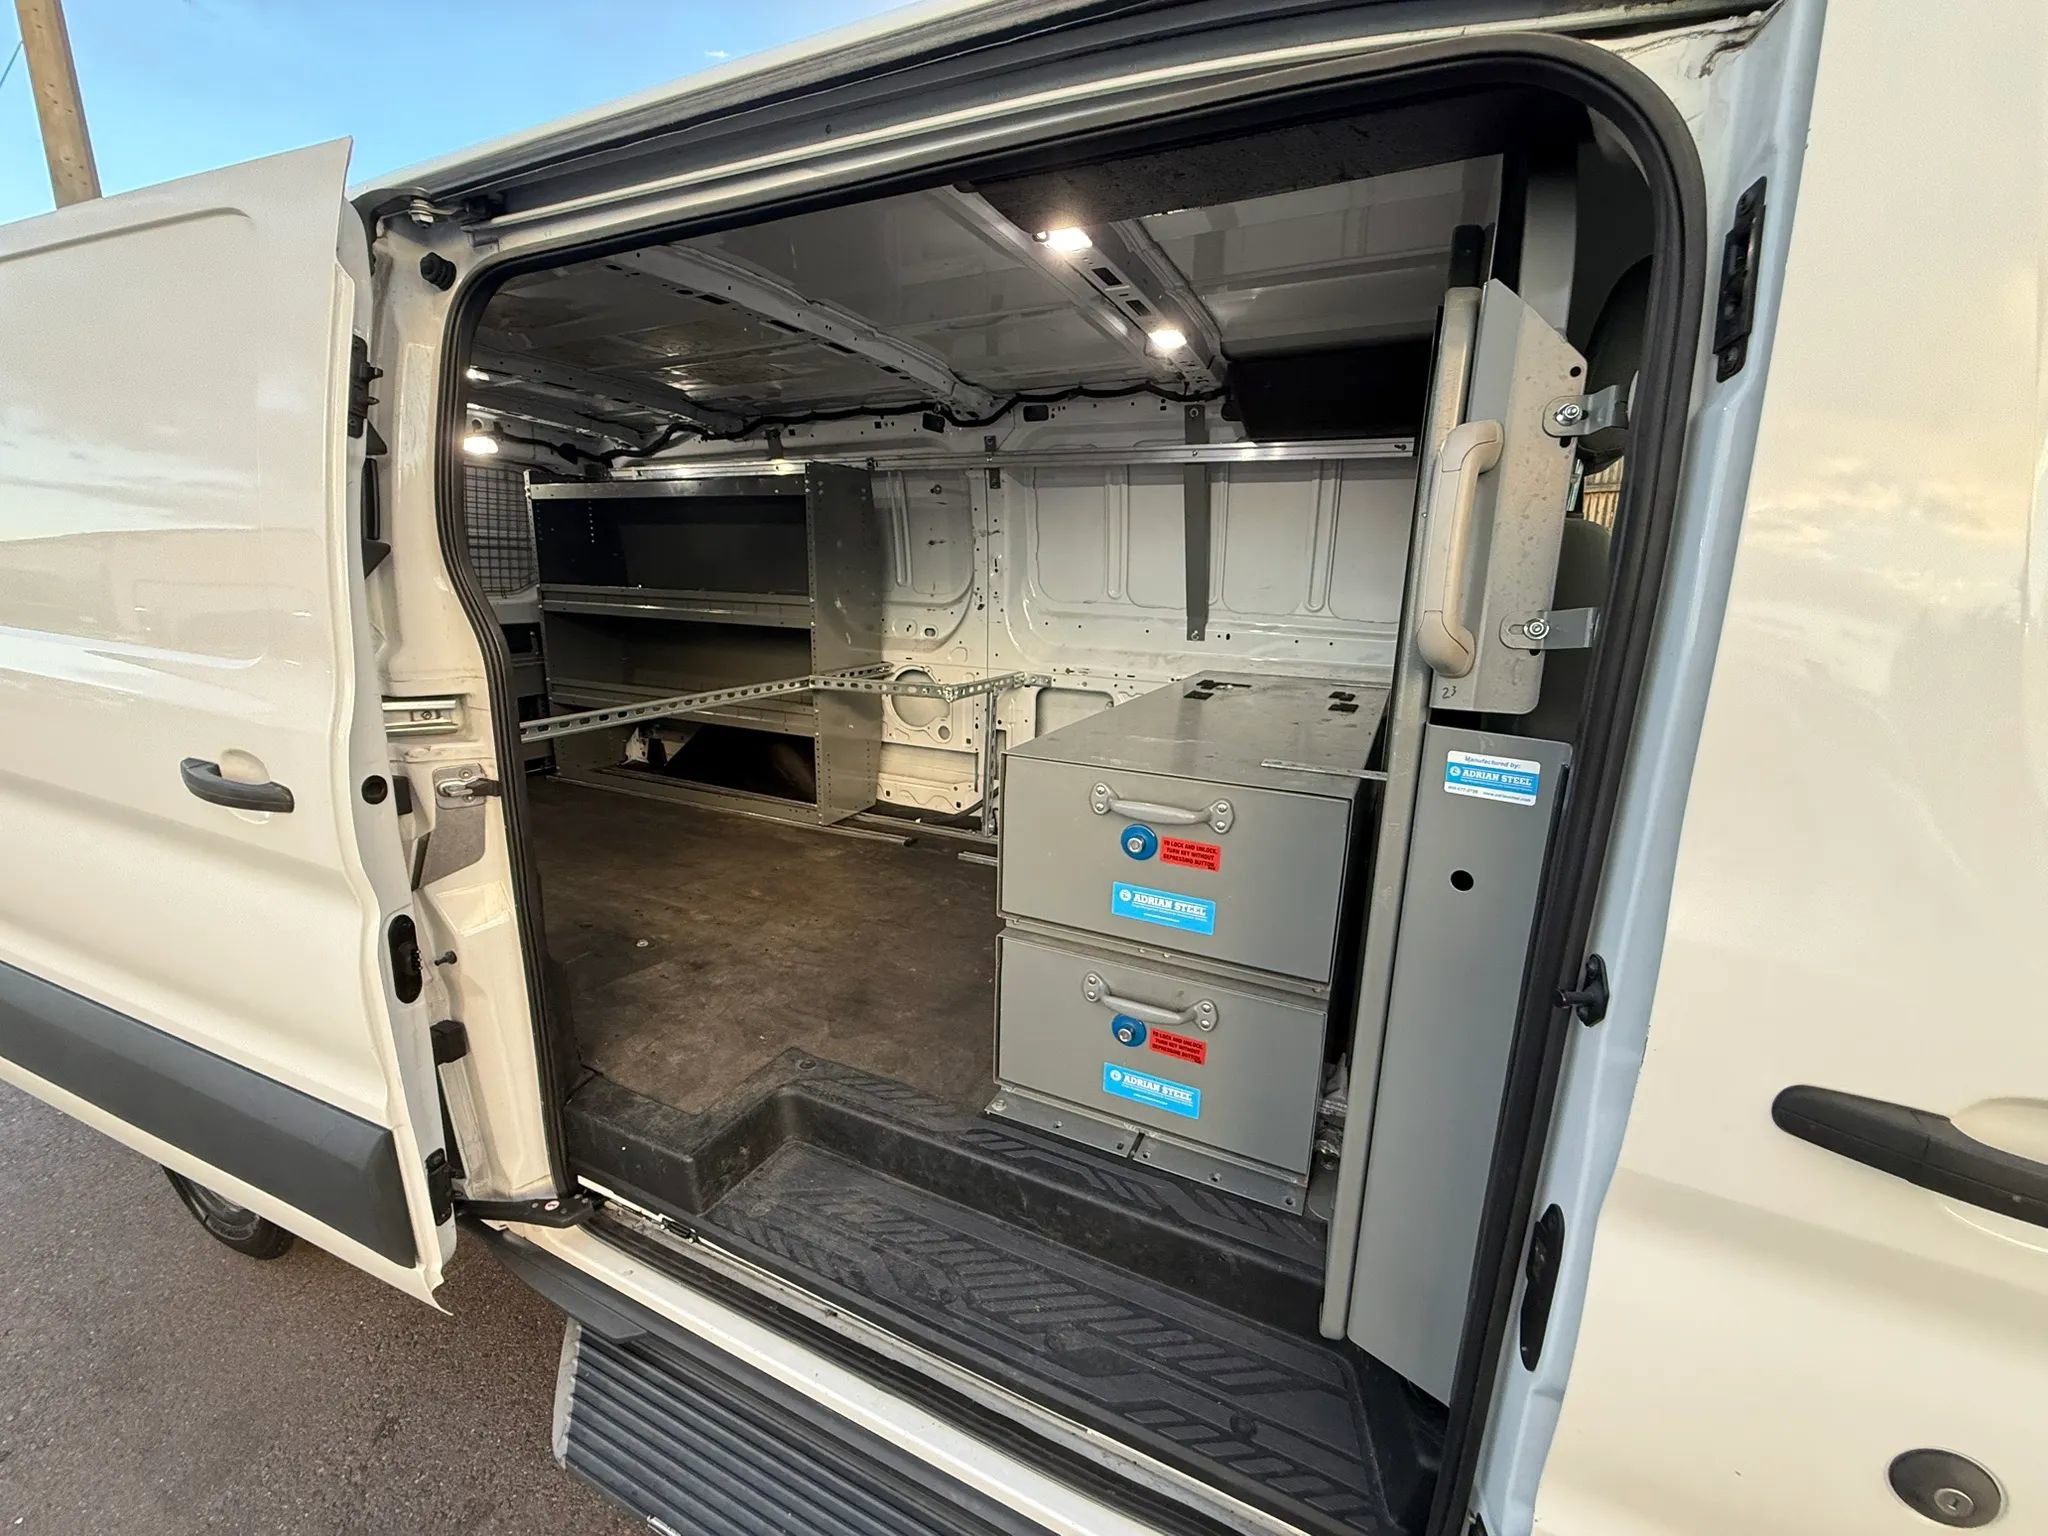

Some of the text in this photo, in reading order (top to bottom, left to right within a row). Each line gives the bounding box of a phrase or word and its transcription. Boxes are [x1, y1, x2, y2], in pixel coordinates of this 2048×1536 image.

[1442, 685, 1457, 699] 23
[1464, 755, 1509, 767] Manufactured
[1462, 769, 1499, 782] ADRIAN
[1501, 774, 1532, 786] STEEL
[1171, 841, 1184, 849] LOCK
[1167, 847, 1180, 855] TURN
[1191, 852, 1215, 861] WITHOUT
[1133, 893, 1173, 909] ADRIAN
[1174, 901, 1207, 916] STEEL
[1124, 1075, 1161, 1092] ADRIAN
[1162, 1086, 1193, 1101] STEEL
